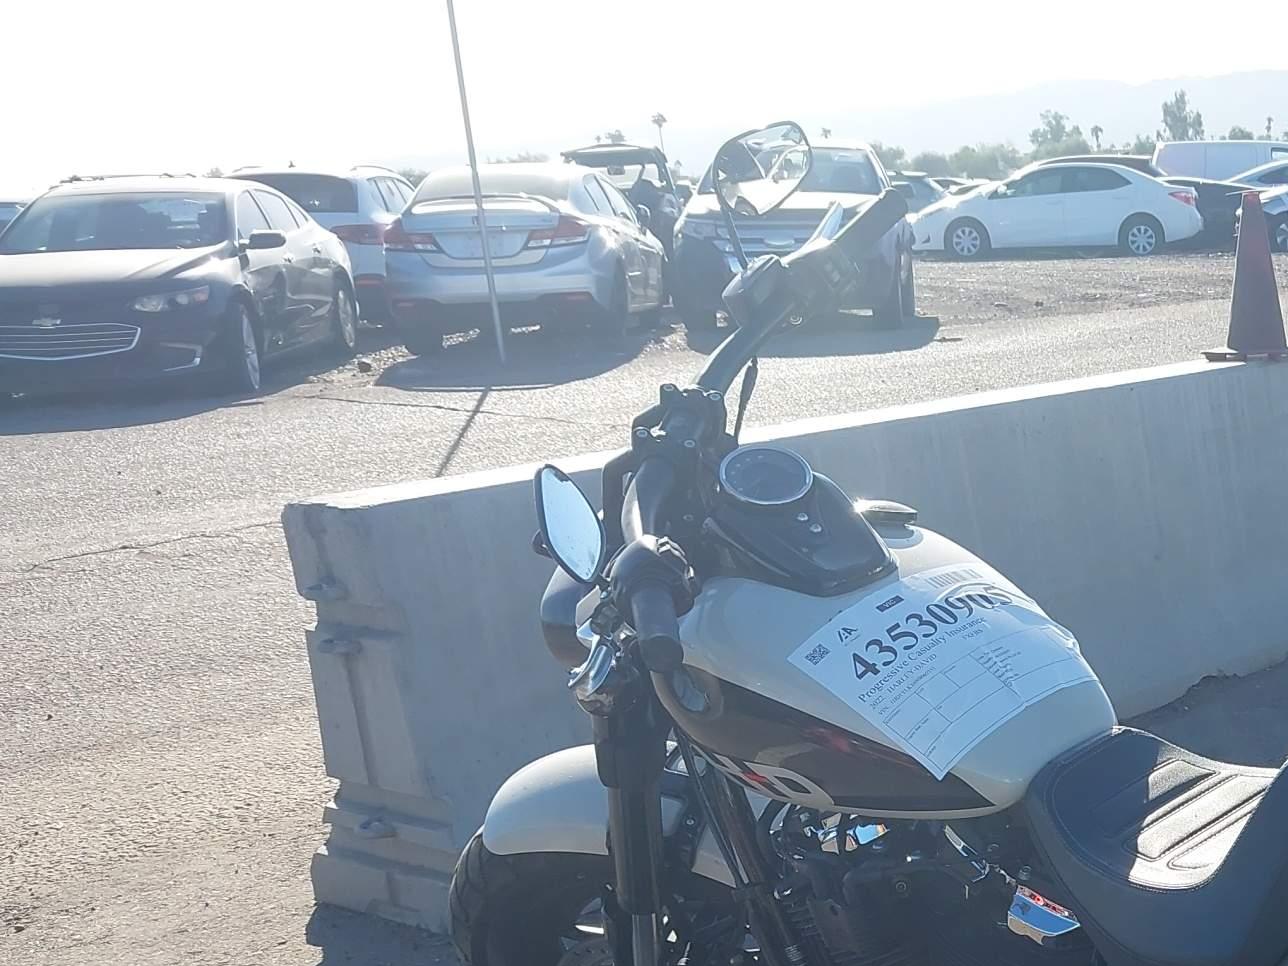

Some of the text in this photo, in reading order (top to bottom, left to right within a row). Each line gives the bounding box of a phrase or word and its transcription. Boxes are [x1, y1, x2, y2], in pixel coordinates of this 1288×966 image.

[852, 585, 1013, 680] 43530905
[857, 660, 909, 703] Progressive
[908, 633, 947, 661] Casualty
[945, 616, 986, 638] Insurance
[870, 695, 885, 710] 2022
[886, 653, 937, 693] HARLEY-DAVID
